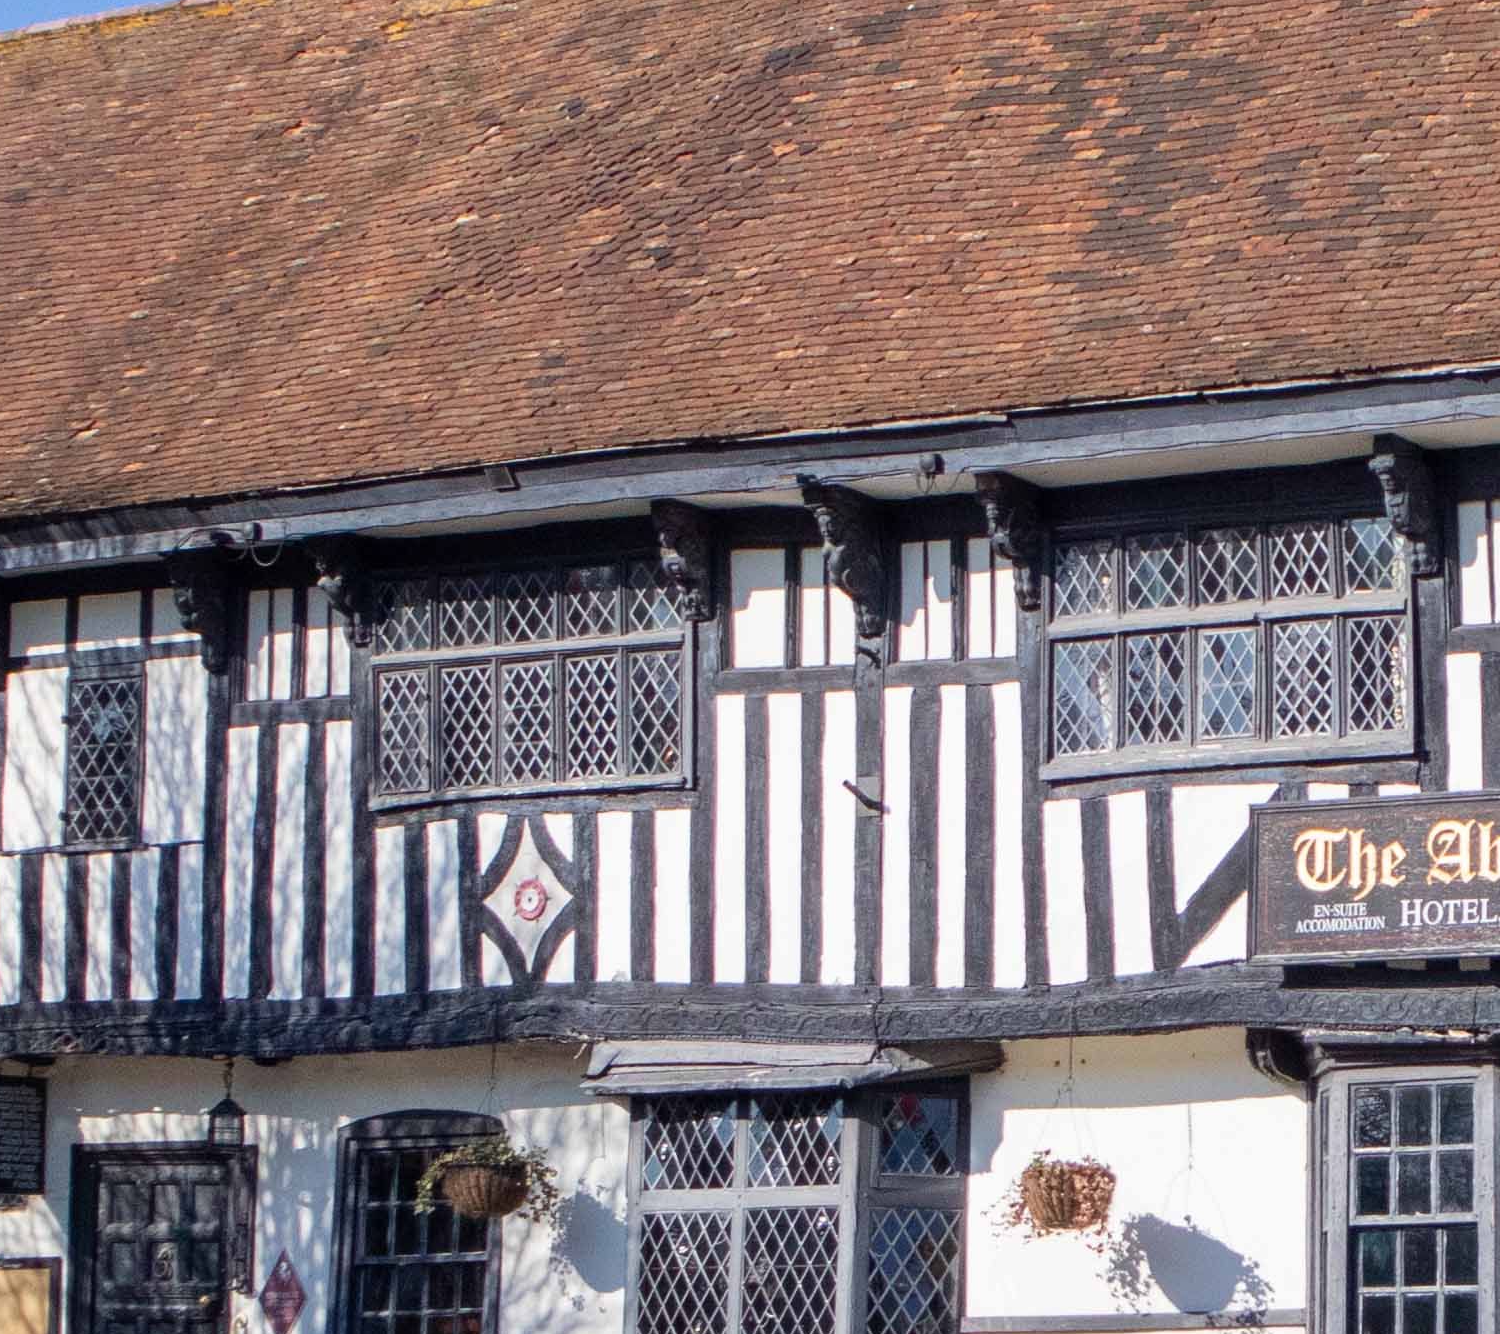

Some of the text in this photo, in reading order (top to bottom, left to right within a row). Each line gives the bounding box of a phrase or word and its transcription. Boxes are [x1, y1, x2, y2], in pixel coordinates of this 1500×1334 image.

[1293, 827, 1407, 902] The
[1313, 901, 1367, 918] EN-SUITE
[1295, 916, 1386, 933] ACCOMODATION
